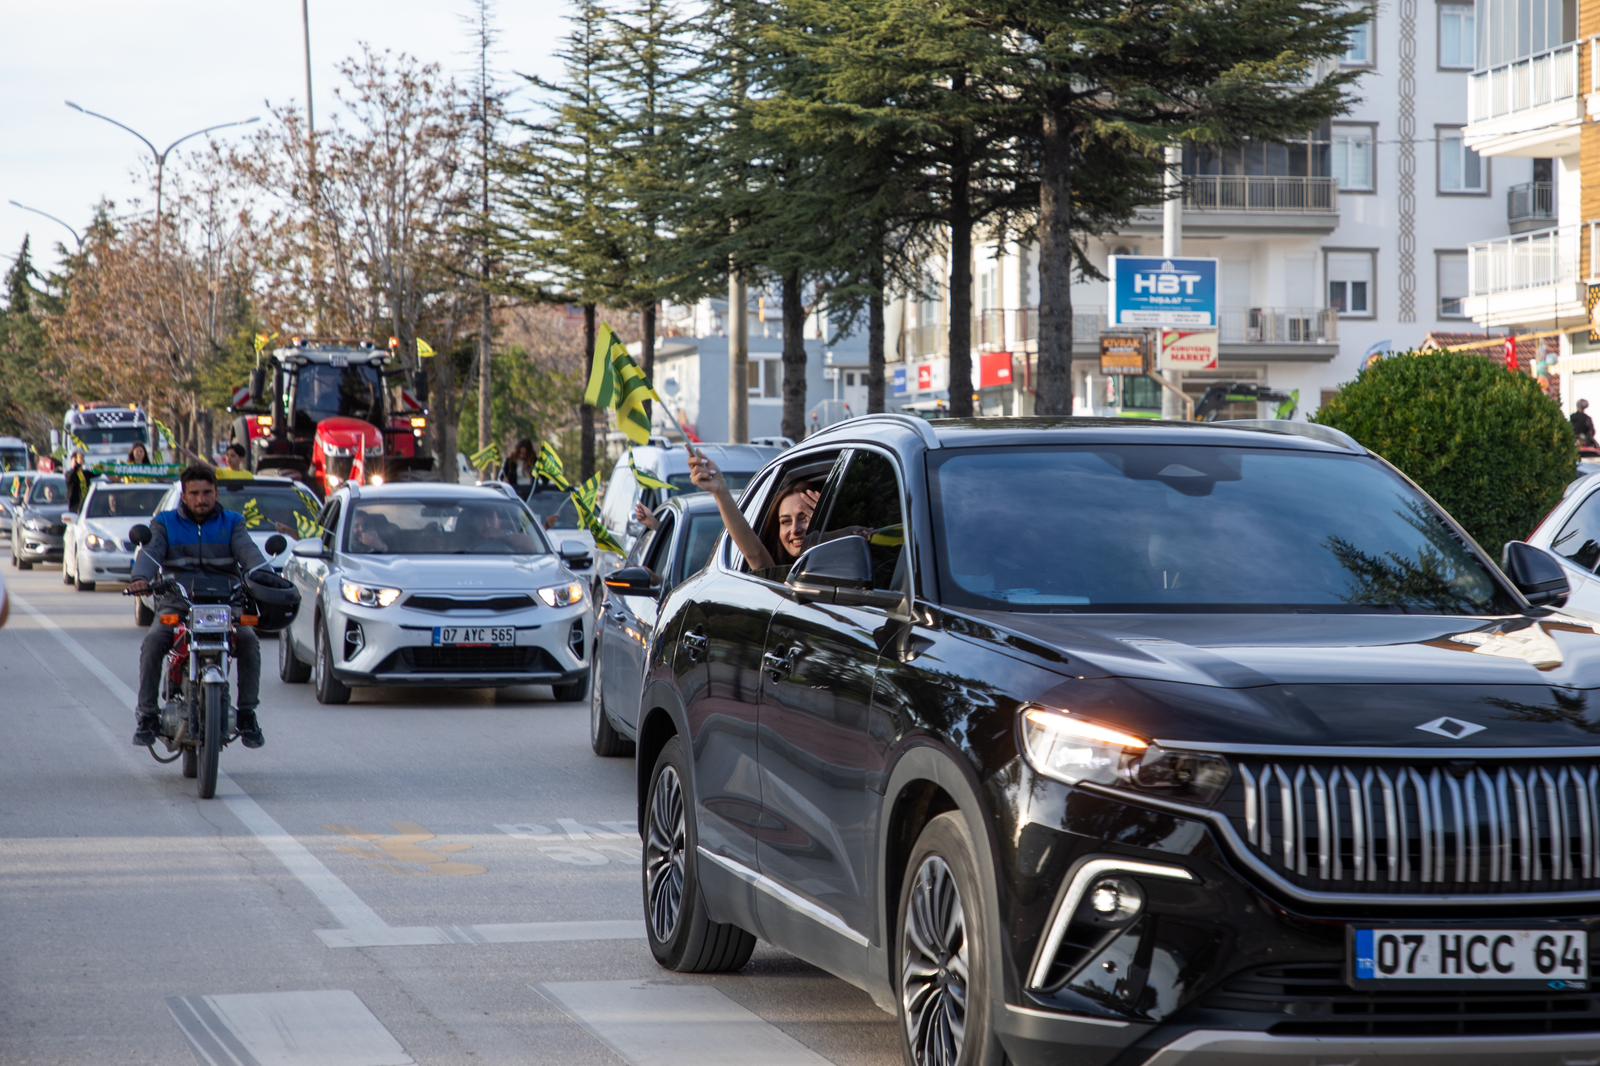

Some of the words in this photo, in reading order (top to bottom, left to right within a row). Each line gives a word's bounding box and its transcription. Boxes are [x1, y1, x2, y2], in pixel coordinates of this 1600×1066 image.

[1134, 274, 1202, 295] HBT
[1171, 353, 1211, 361] MARKET
[443, 628, 457, 642] 07
[463, 628, 485, 642] AYC
[491, 628, 513, 642] 565
[1377, 934, 1424, 975] 07
[1439, 934, 1515, 975] HCC
[1535, 935, 1582, 975] 64
